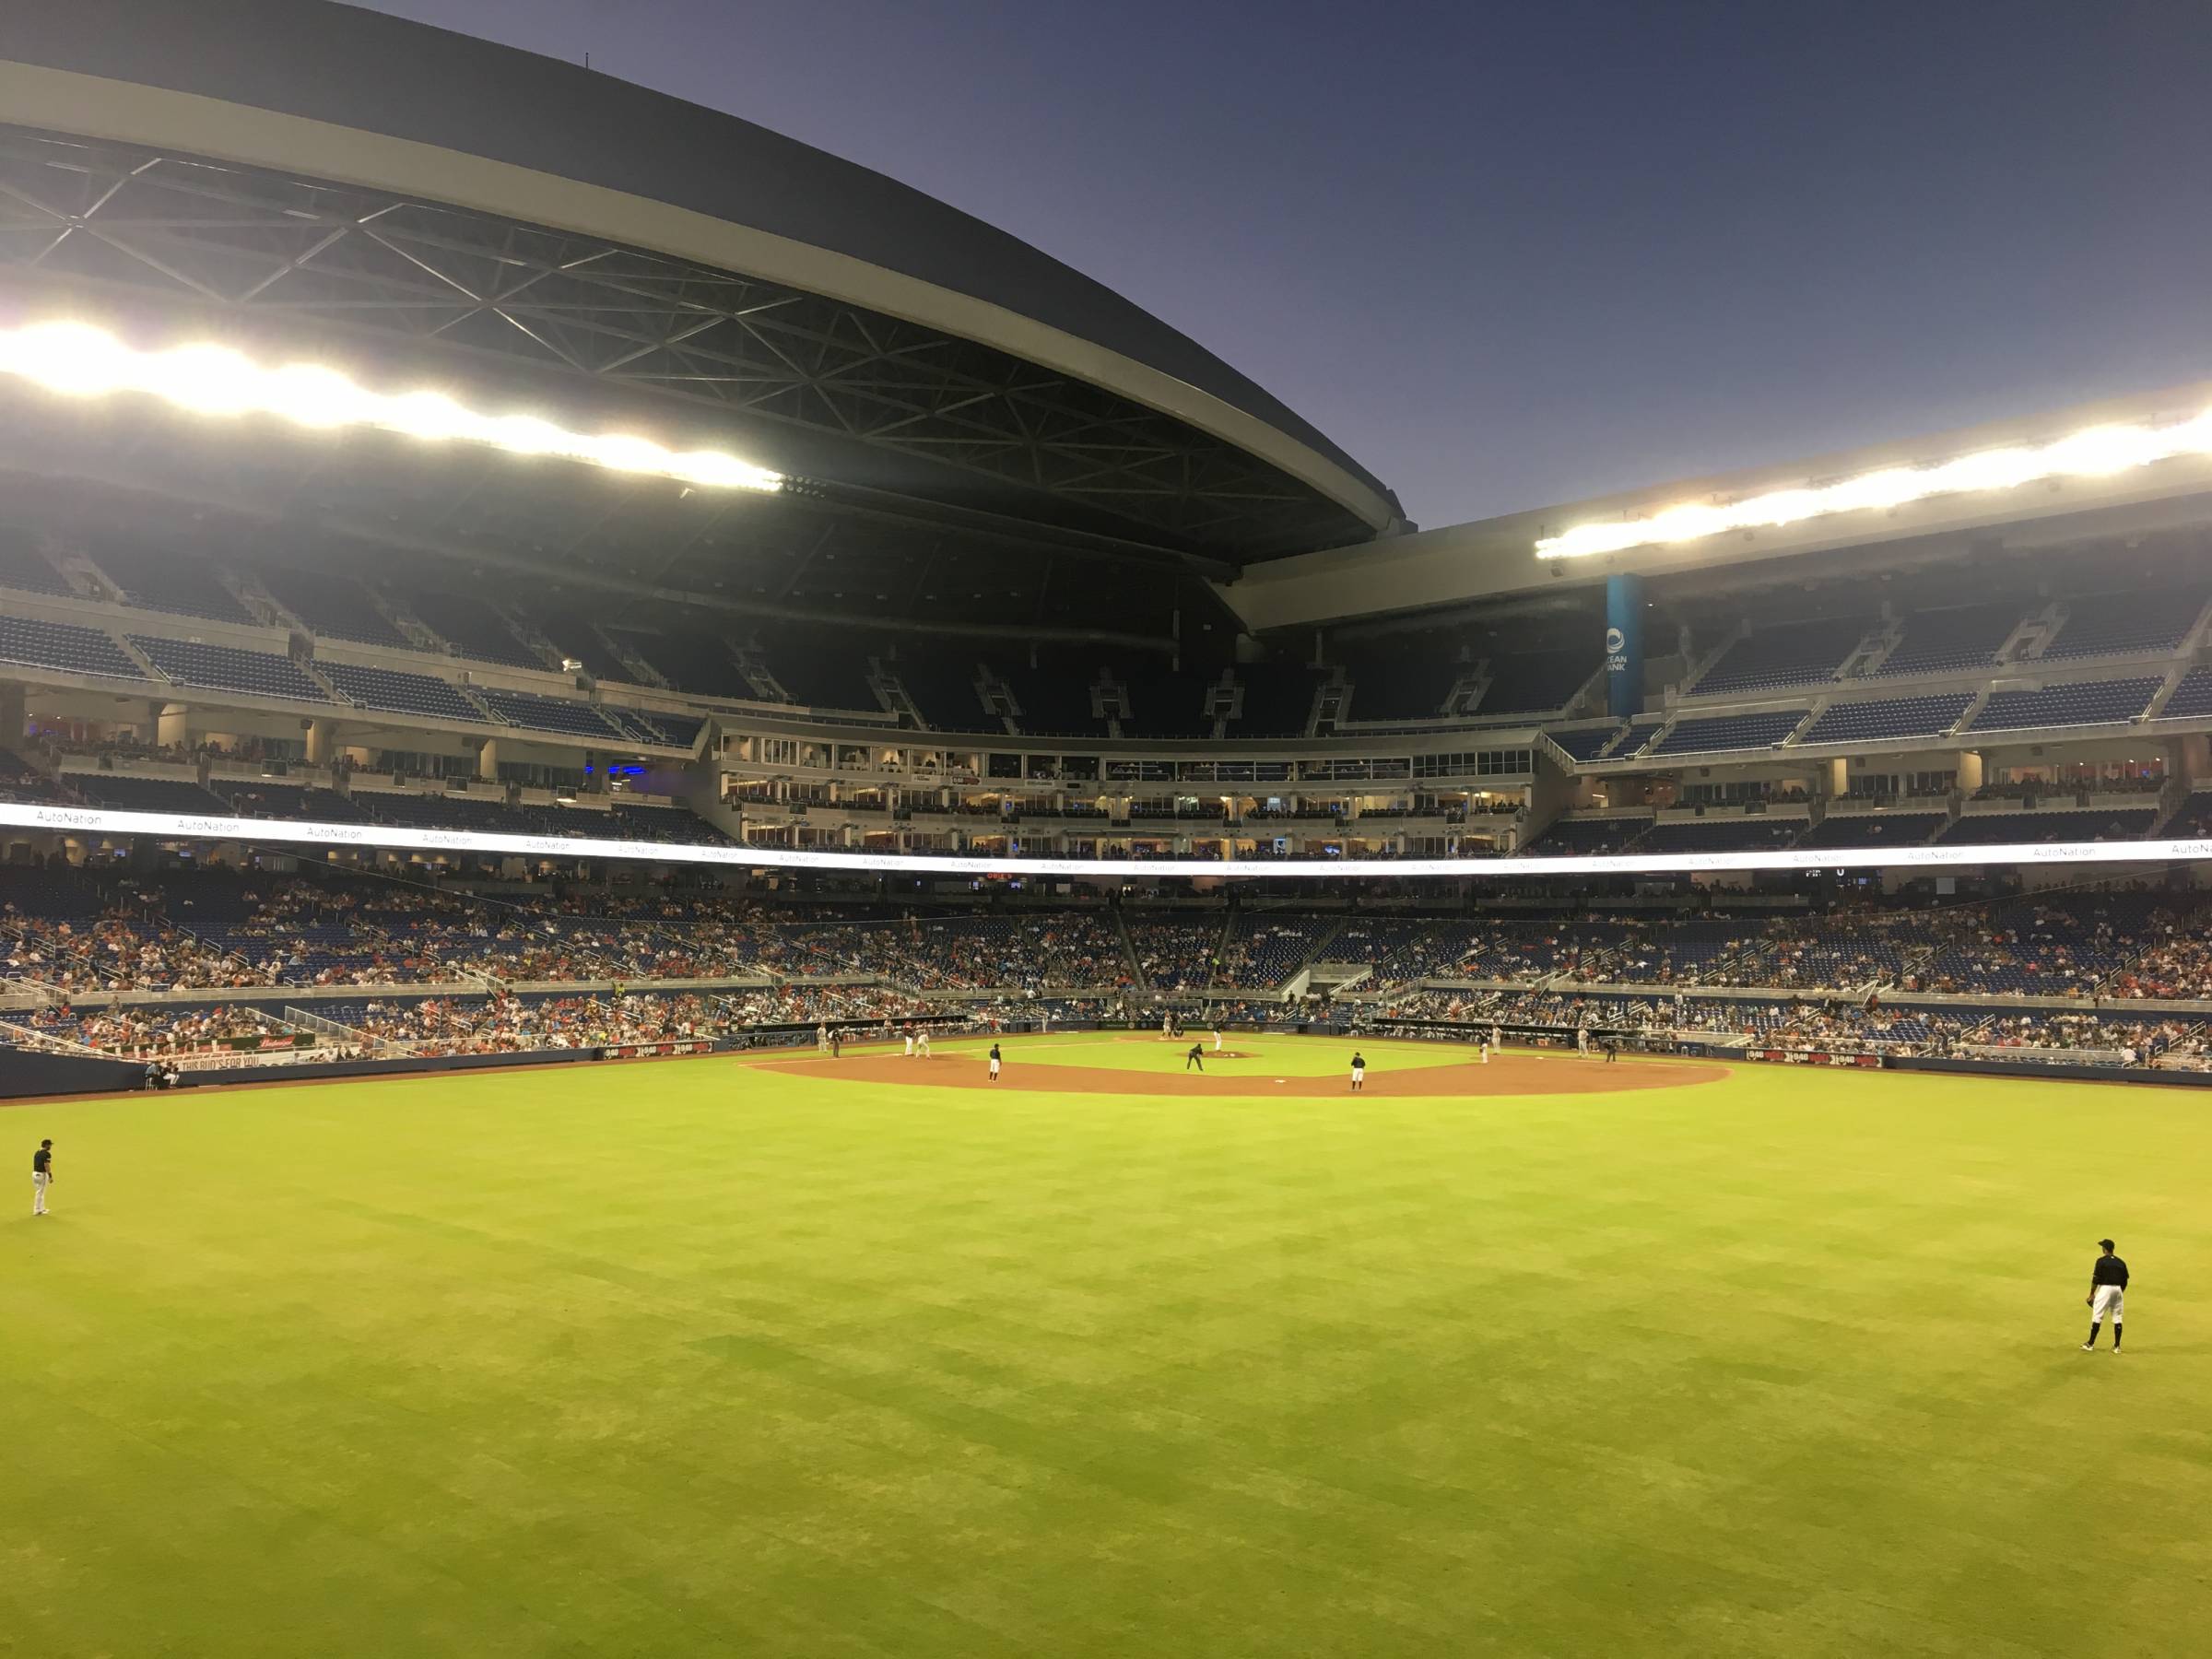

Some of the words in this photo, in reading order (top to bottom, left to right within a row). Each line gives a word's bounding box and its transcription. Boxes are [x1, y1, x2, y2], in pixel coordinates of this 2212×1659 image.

[1607, 663, 1625, 671] ANK
[37, 811, 101, 825] AutoNation
[177, 819, 240, 832] AutoNation
[306, 827, 362, 840] AutoNation
[422, 833, 472, 844] AutoNation
[525, 840, 571, 850] AutoNation
[618, 845, 659, 855] AutoNation
[701, 850, 738, 859] AutoNation
[1907, 851, 1964, 861] AutoNation
[2033, 847, 2096, 858] AutoNation
[779, 854, 819, 864] AutoNation
[862, 857, 904, 866] AutoNation
[1792, 853, 1844, 865] AutoNation
[950, 860, 993, 870] AutoNation
[1041, 863, 1084, 872] AutoNation
[182, 1062, 199, 1071] THIS
[200, 1059, 223, 1070] BUD'S
[225, 1057, 241, 1067] FOR
[243, 1056, 259, 1067] YOU
